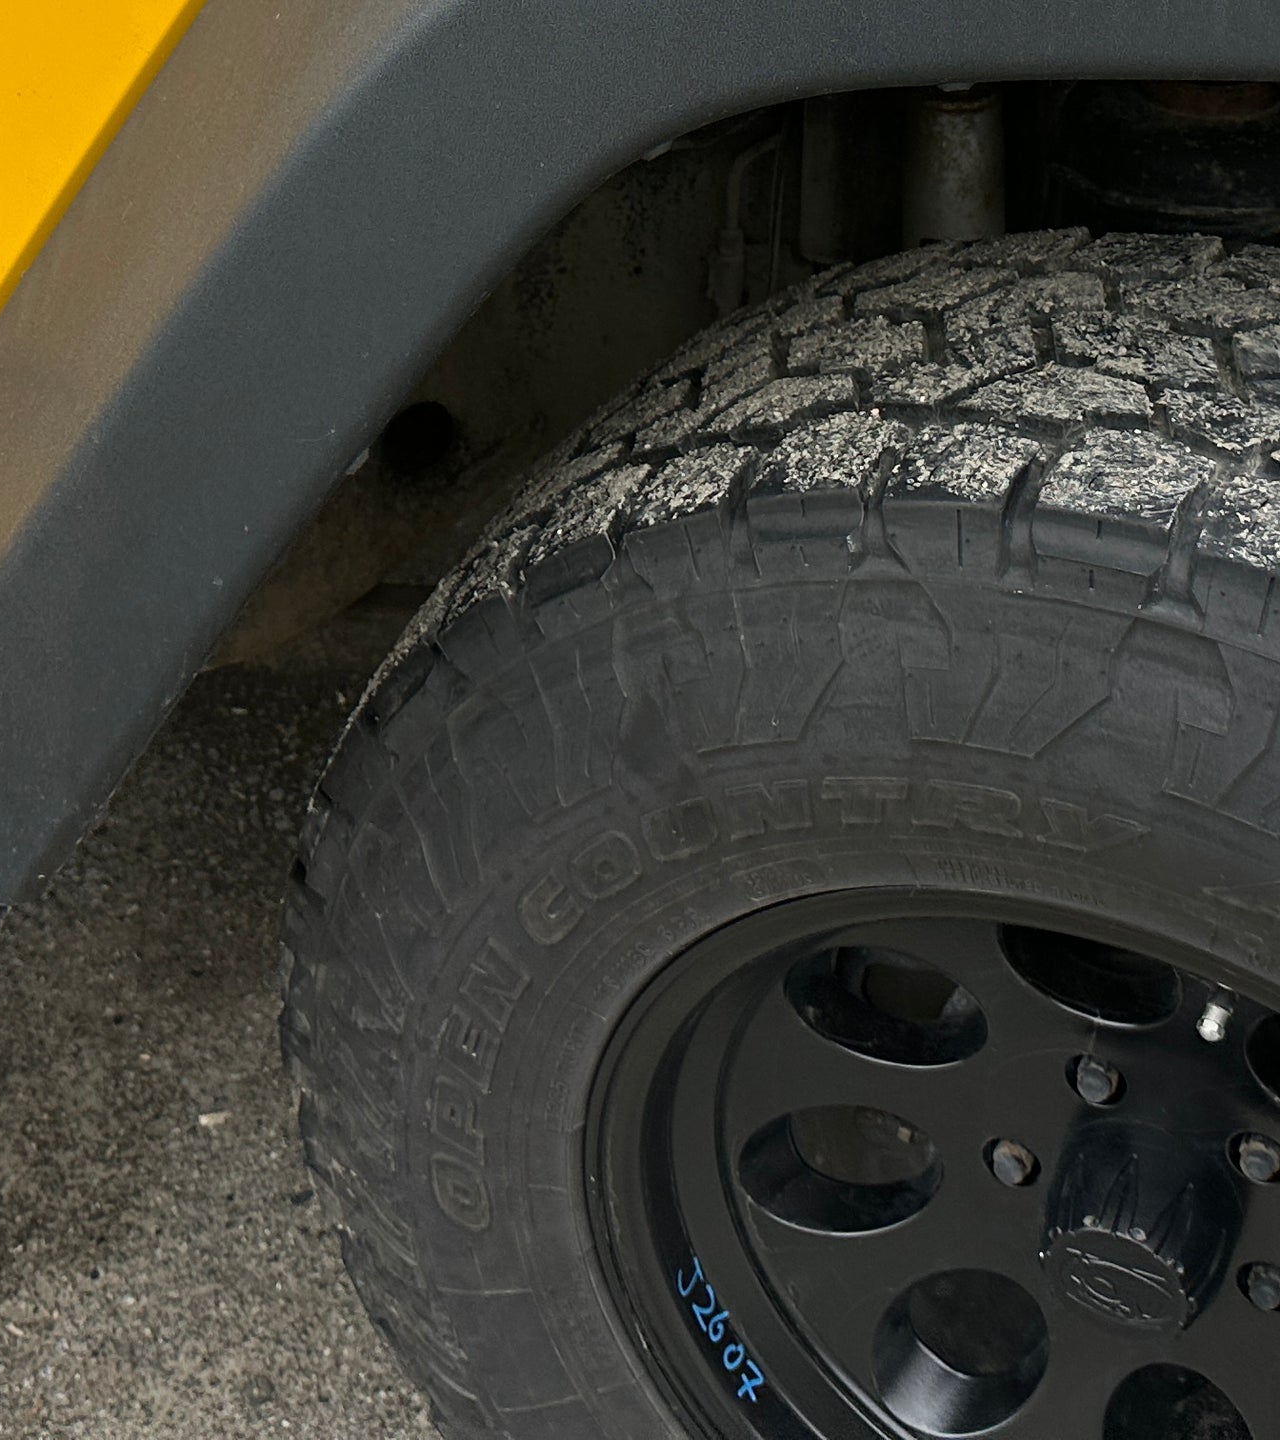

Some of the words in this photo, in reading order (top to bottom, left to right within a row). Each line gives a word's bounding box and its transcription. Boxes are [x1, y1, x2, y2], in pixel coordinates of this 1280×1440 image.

[430, 936, 531, 1232] OPEN
[523, 774, 1152, 947] COUNTRY
[677, 1256, 764, 1402] J2607
